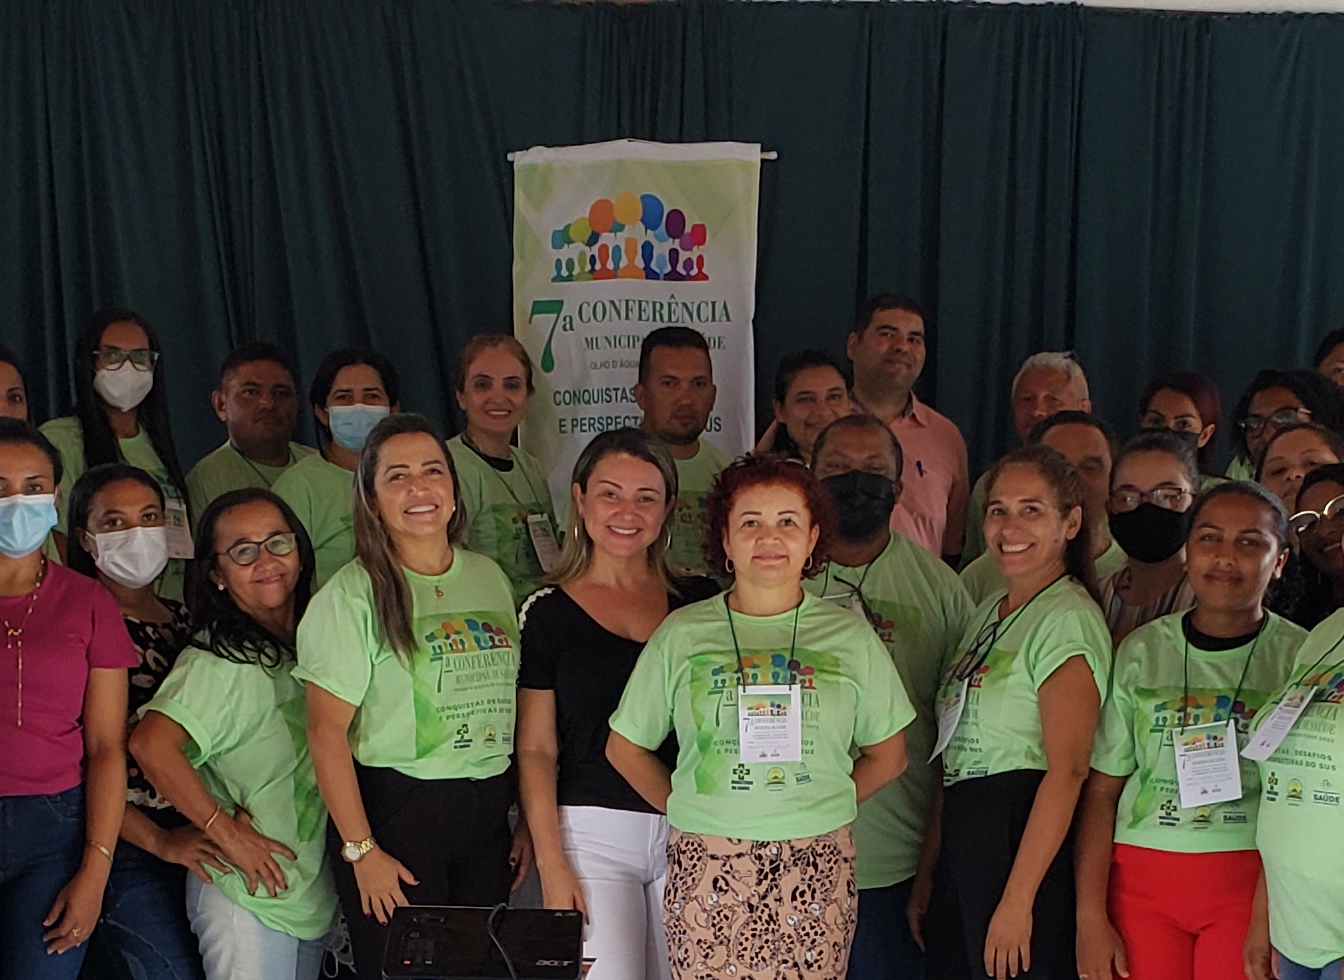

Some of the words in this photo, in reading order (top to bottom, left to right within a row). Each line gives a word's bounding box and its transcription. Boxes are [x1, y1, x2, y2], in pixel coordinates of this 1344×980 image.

[578, 294, 731, 324] CONFERÊNCIA
[583, 334, 644, 351] MUNICIP
[590, 360, 610, 370] OLHO
[553, 387, 637, 406] CONQUISTAS
[559, 418, 567, 434] E
